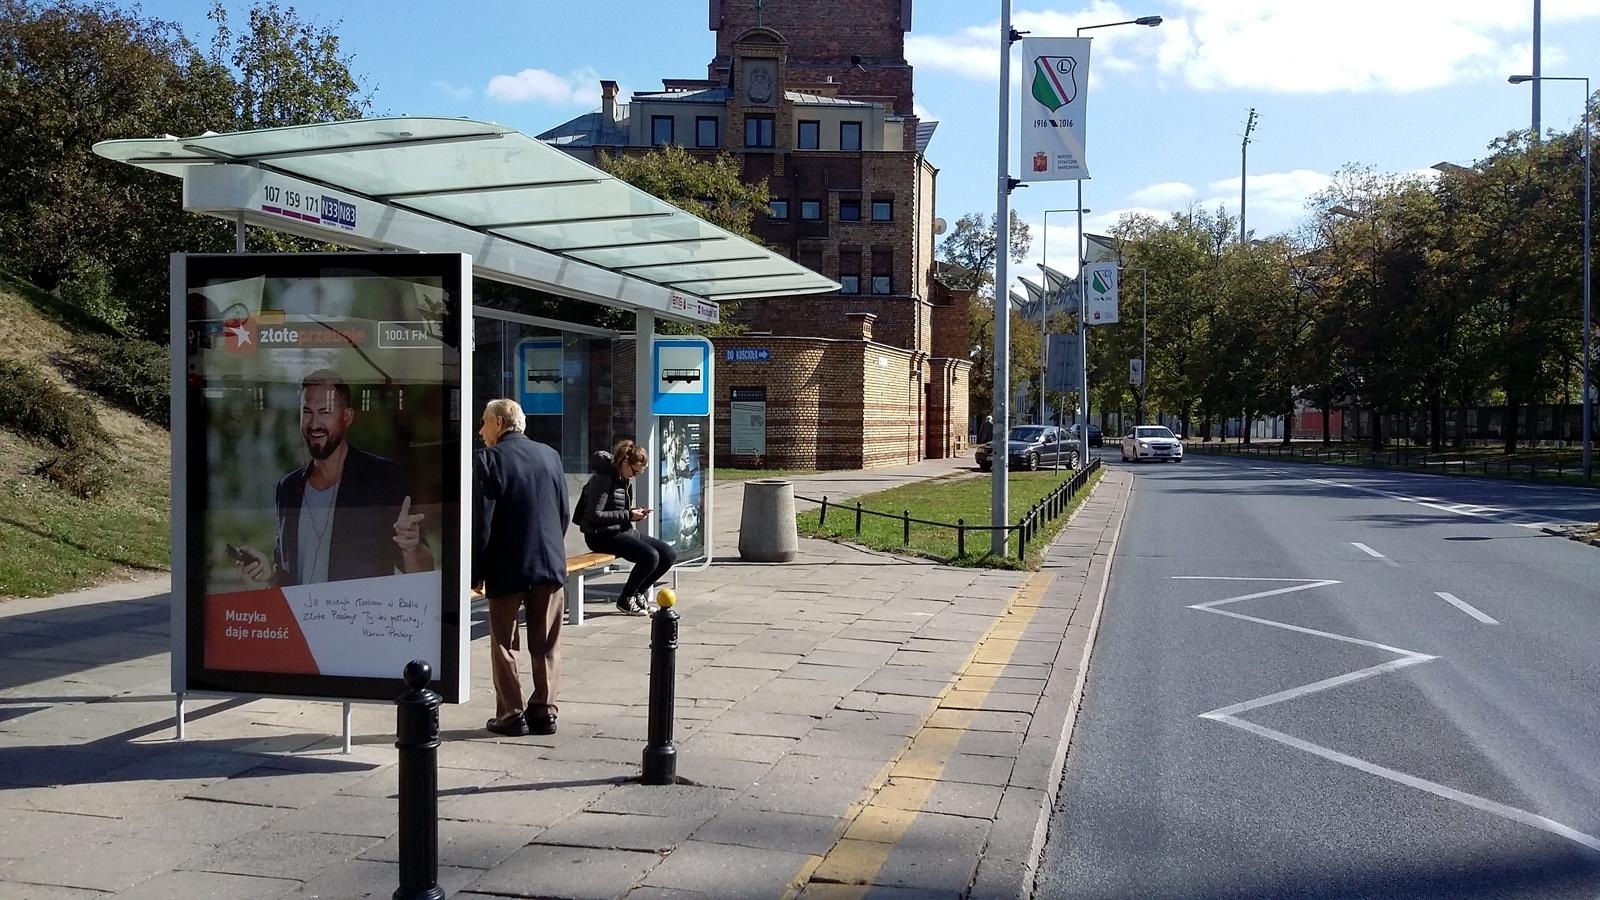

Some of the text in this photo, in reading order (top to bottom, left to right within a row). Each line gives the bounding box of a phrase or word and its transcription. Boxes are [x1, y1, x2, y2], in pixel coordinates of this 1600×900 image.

[1034, 119, 1073, 128] 1916 2016
[264, 185, 355, 223] 107 159 171 N33 N83
[384, 329, 428, 342] 100.1 FM
[225, 609, 267, 624] Muzyka
[225, 626, 289, 640] daje radość
